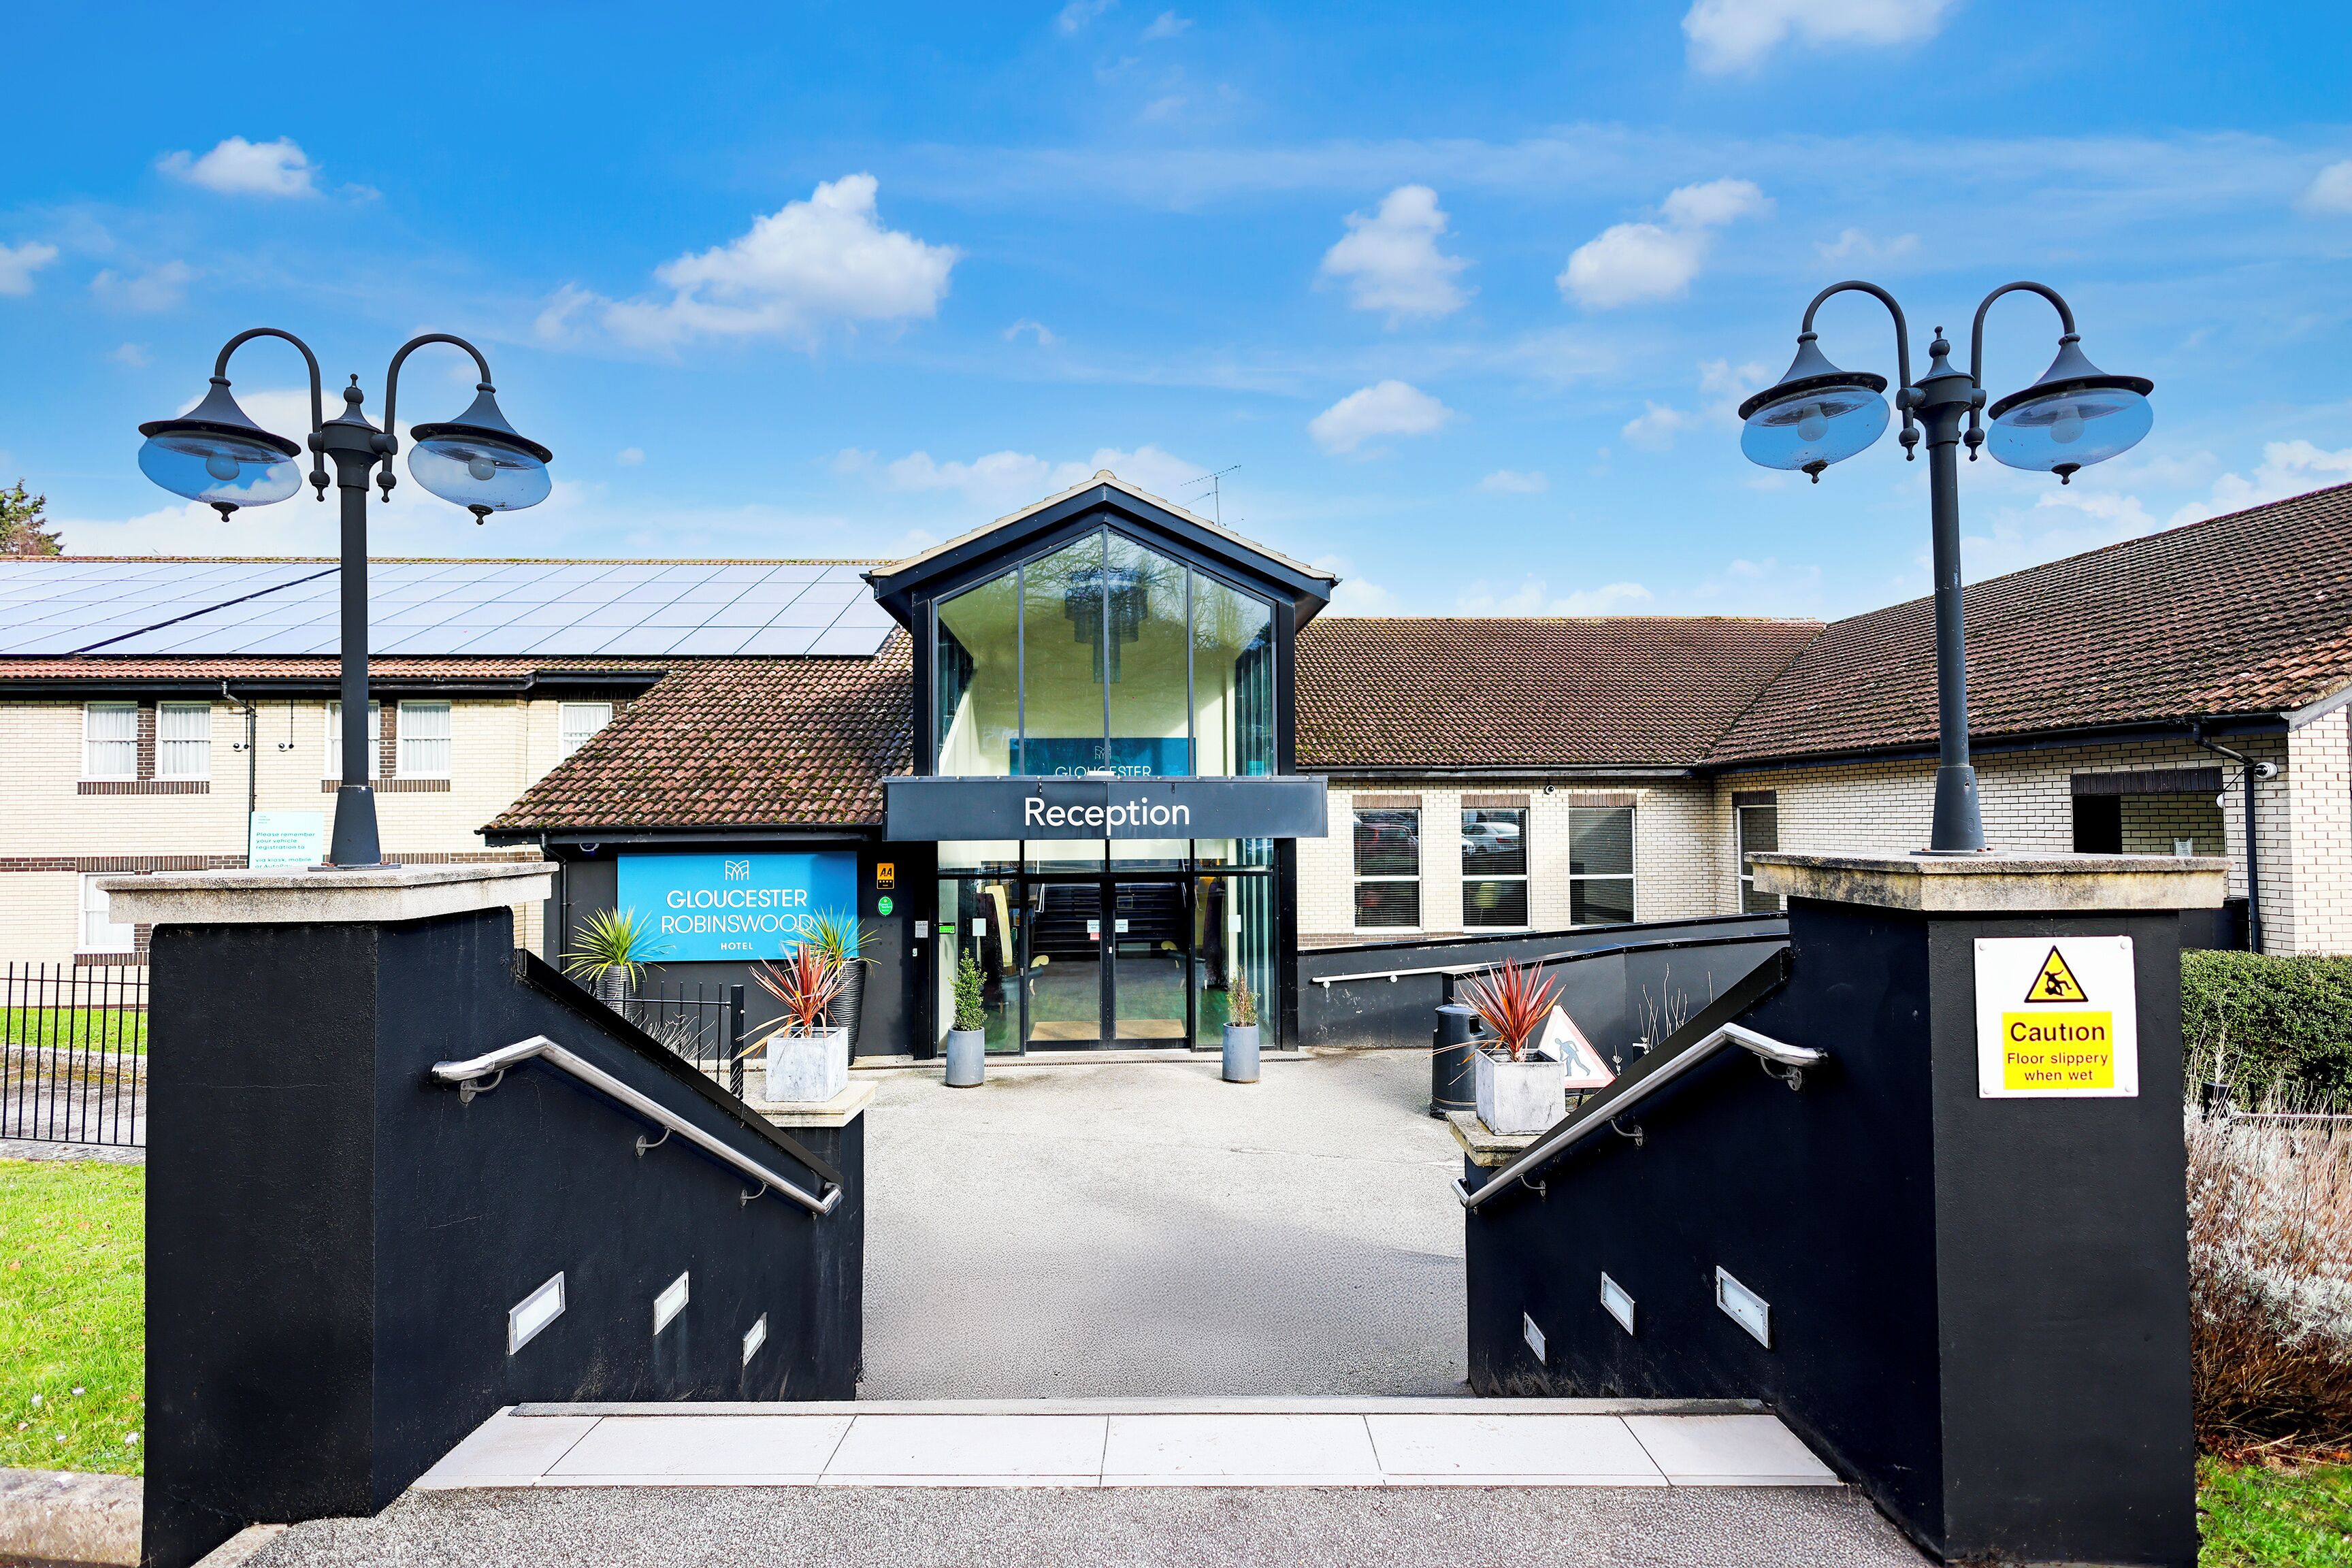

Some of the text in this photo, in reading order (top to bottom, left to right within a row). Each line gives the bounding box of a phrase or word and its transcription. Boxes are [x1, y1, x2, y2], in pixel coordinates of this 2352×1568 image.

[1025, 797, 1190, 836] Reception
[880, 867, 892, 877] AA
[666, 889, 808, 909] GLOUCESTER
[661, 914, 813, 934] ROBINSWOOD
[720, 942, 753, 950] HOTEL
[2010, 1022, 2105, 1042] Caution
[2008, 1052, 2108, 1066] Floor slippery
[2025, 1070, 2093, 1081] when wet
